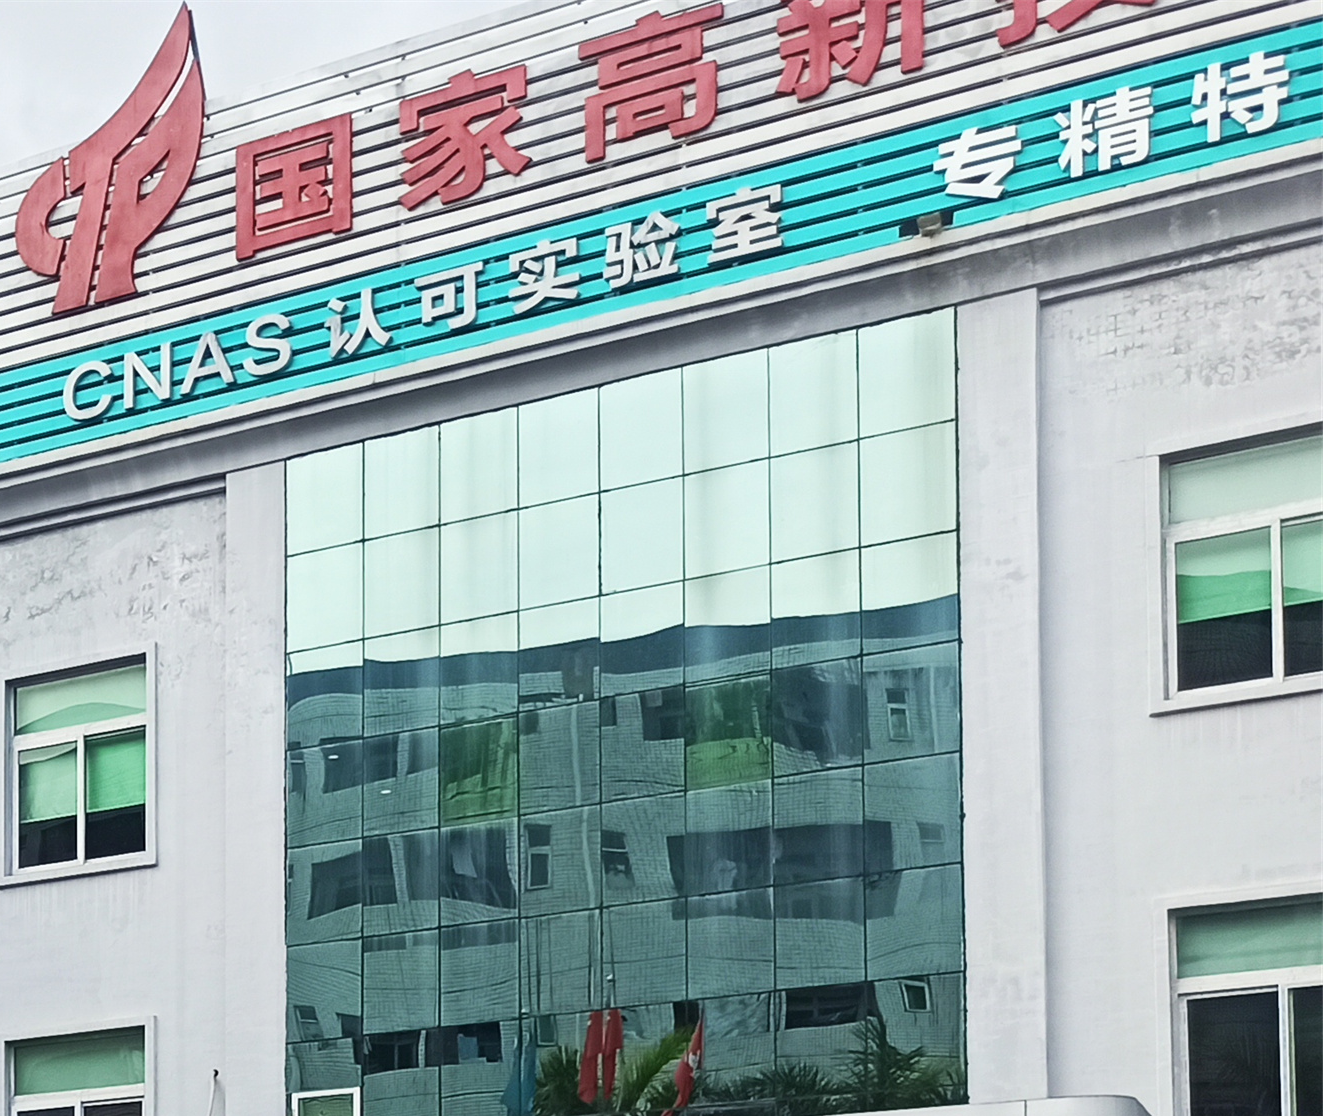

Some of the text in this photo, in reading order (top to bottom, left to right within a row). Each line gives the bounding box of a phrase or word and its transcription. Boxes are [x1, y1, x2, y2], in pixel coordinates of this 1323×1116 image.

[235, 0, 1155, 262] 国家高新
[932, 50, 1291, 199] 专精特
